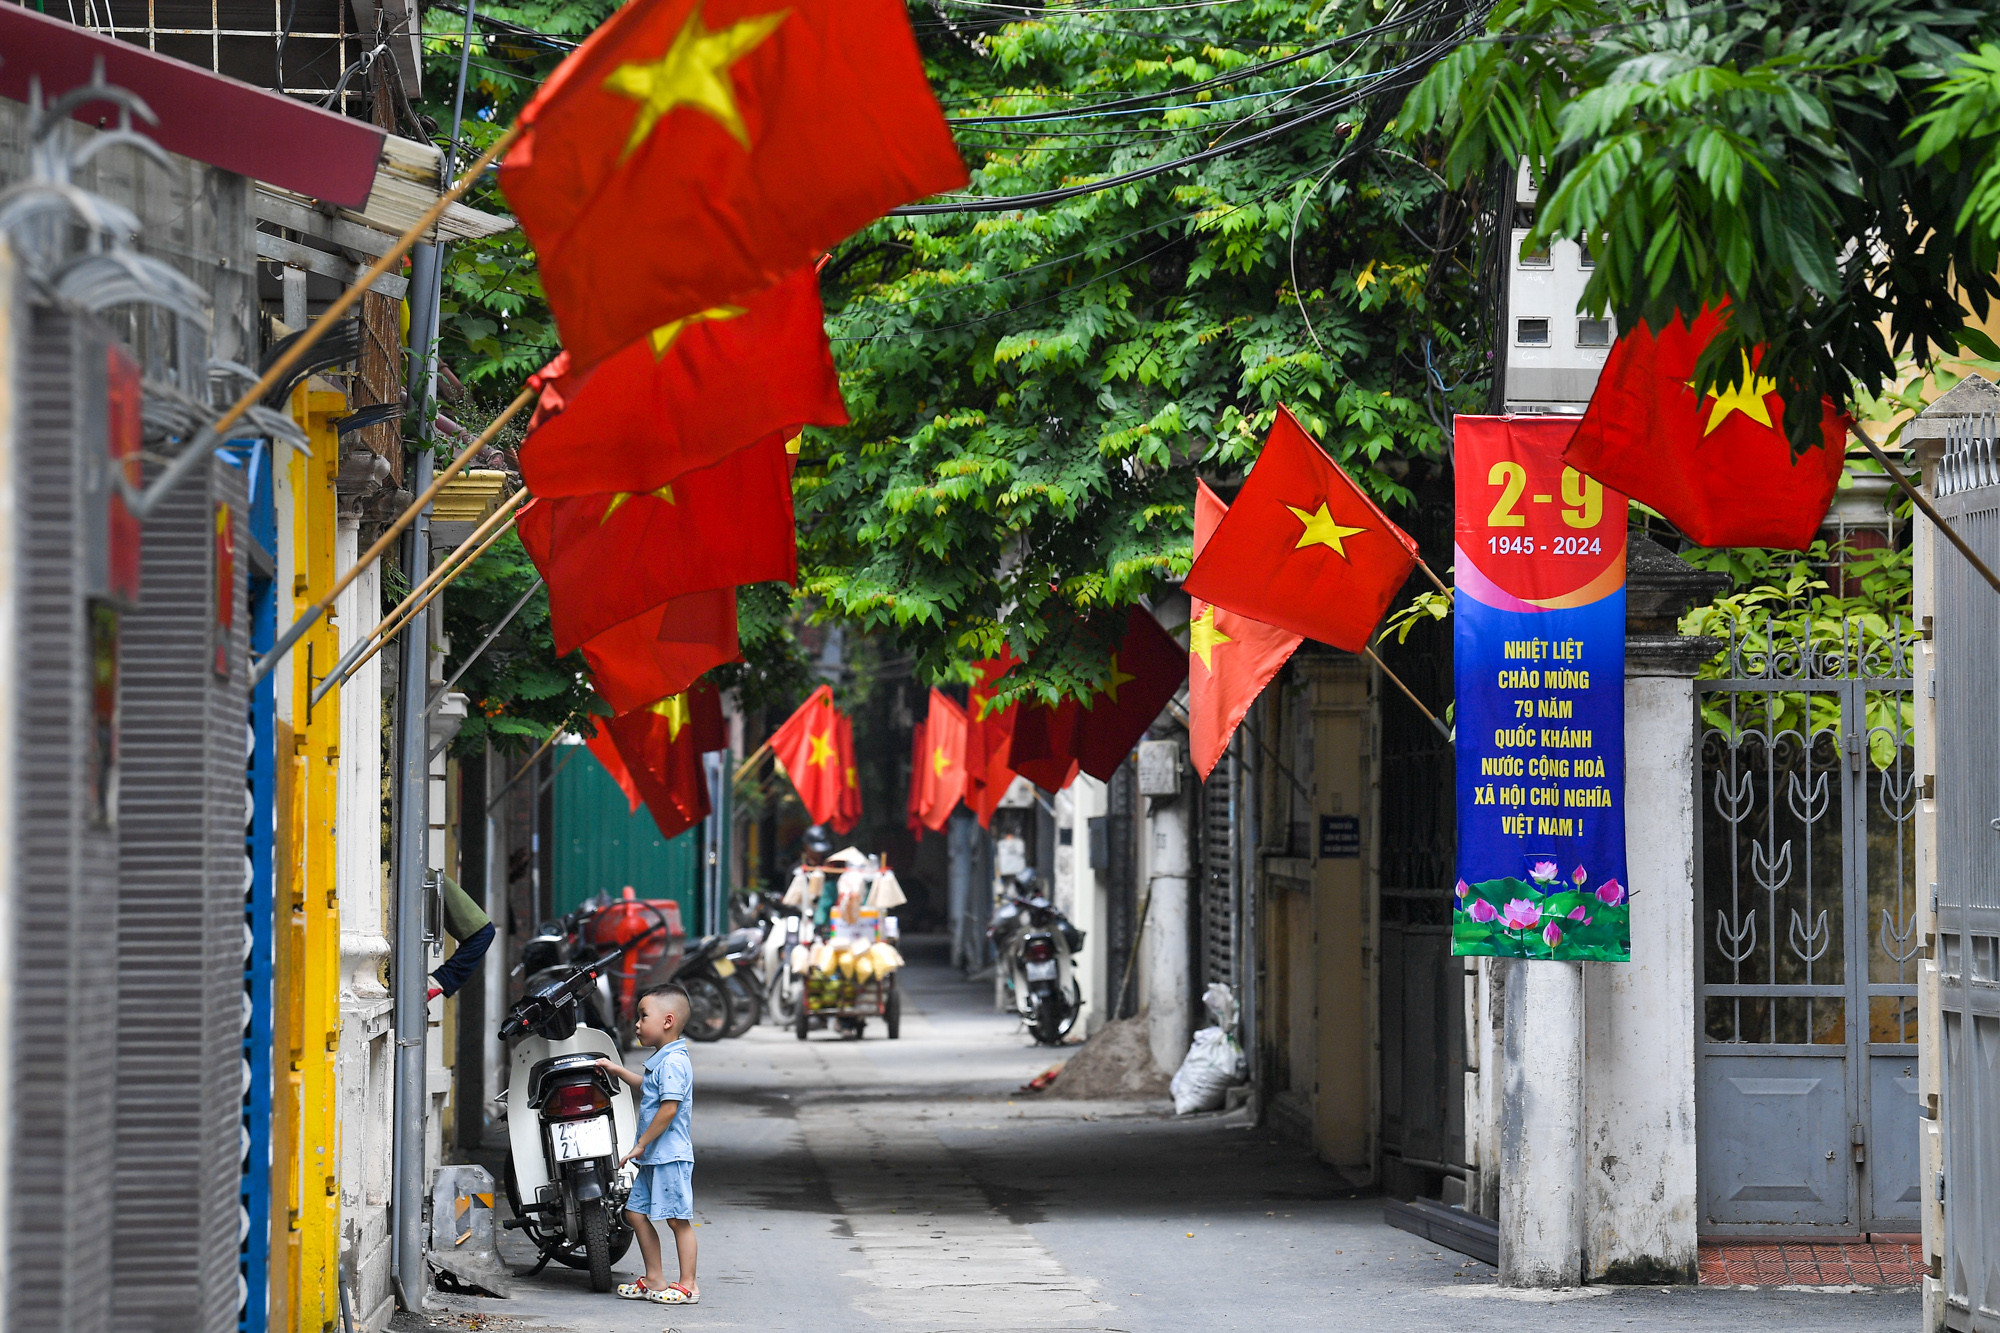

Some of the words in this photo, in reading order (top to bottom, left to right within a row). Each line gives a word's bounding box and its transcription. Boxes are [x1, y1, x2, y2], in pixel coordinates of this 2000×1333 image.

[1487, 460, 1603, 529] 2-9
[1488, 536, 1534, 555] 1945
[1553, 536, 1602, 555] 2024
[1504, 637, 1548, 663] NHIỆT
[1553, 637, 1584, 664] LIỆT
[1498, 666, 1540, 689] CHÀO
[1544, 667, 1590, 689] MỪNG
[1514, 700, 1534, 718] 79
[1538, 696, 1573, 719] NĂM
[1495, 722, 1536, 749] QUỐC
[1541, 726, 1592, 748] KHÁNH
[1481, 754, 1524, 777] NƯỚC
[1528, 754, 1570, 781] CỘNG
[1574, 755, 1605, 778] HOÀ
[1474, 783, 1495, 805] XÃ
[1500, 783, 1526, 810] HỘI
[1530, 782, 1560, 807] CHỦ
[1564, 785, 1612, 808] NGHĨA
[1501, 812, 1534, 839] VIỆT
[1538, 817, 1573, 837] NAM
[1578, 818, 1584, 837] !
[553, 1057, 588, 1066] HONDA
